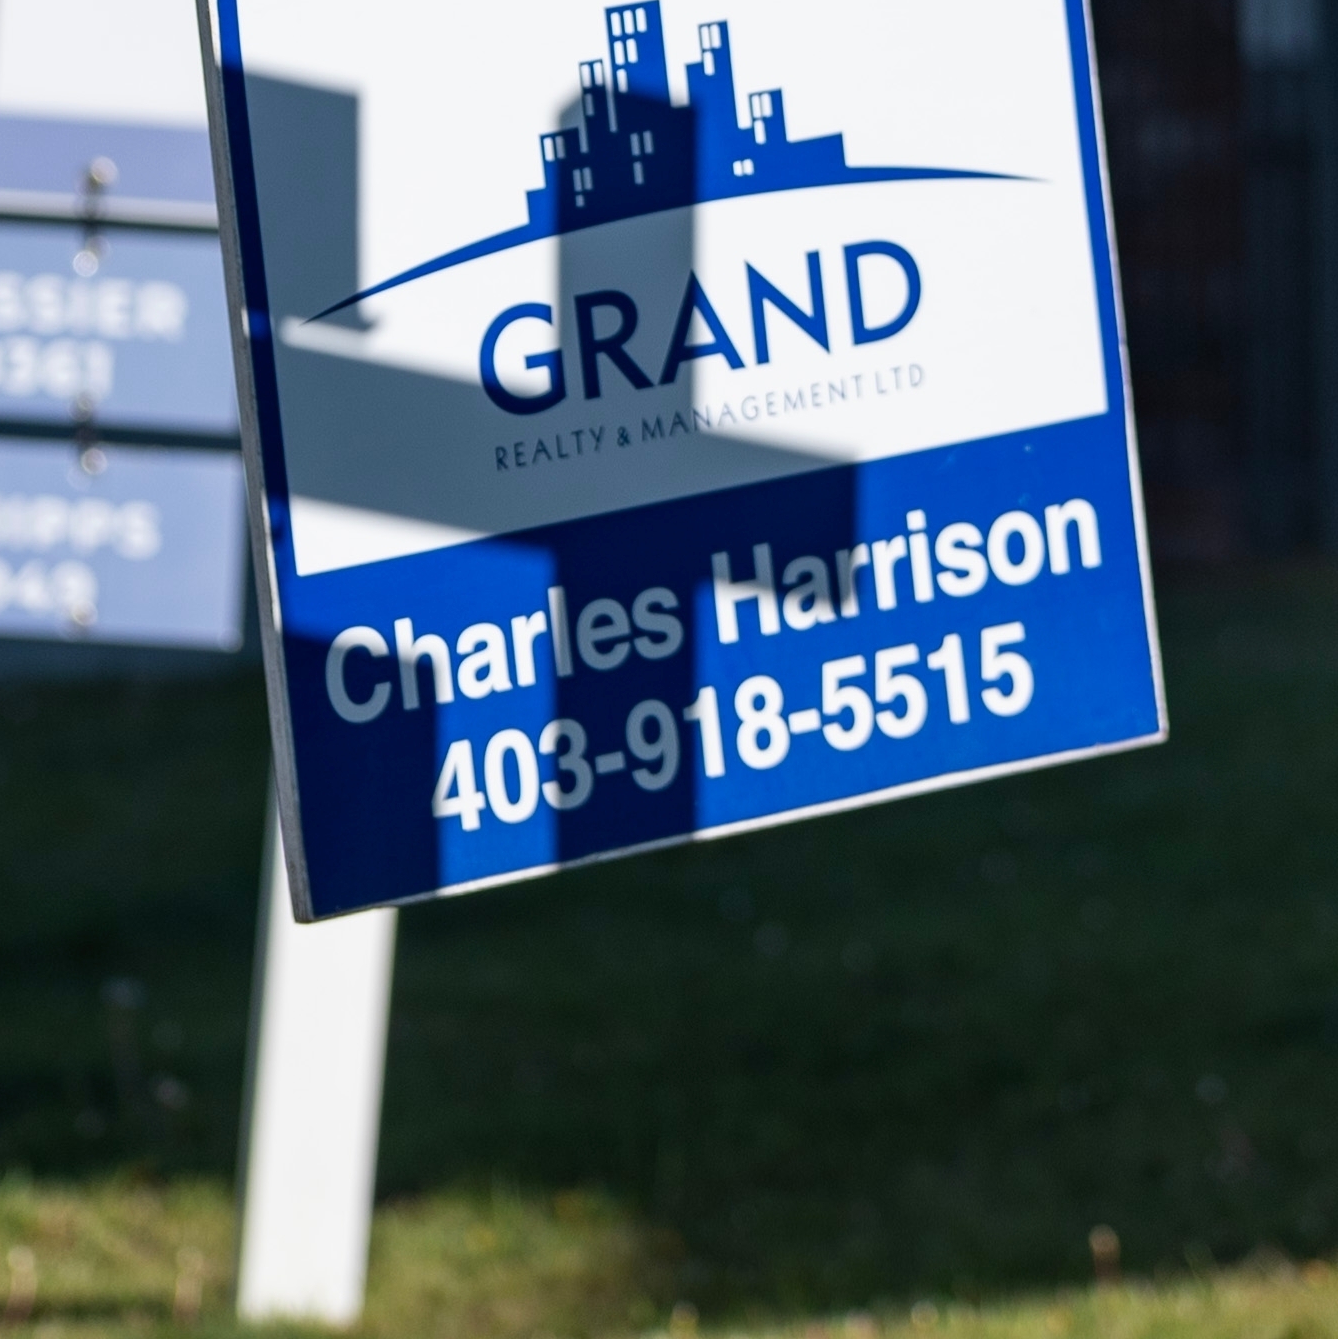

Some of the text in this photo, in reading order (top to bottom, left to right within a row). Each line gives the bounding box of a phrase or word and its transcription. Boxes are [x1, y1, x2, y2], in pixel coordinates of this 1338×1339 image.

[481, 242, 920, 416] GRAND
[495, 364, 923, 470] REALTY & MANAGEMENT LTD
[328, 499, 1101, 721] Charles Harrison
[434, 621, 1034, 831] 403-918-5515
